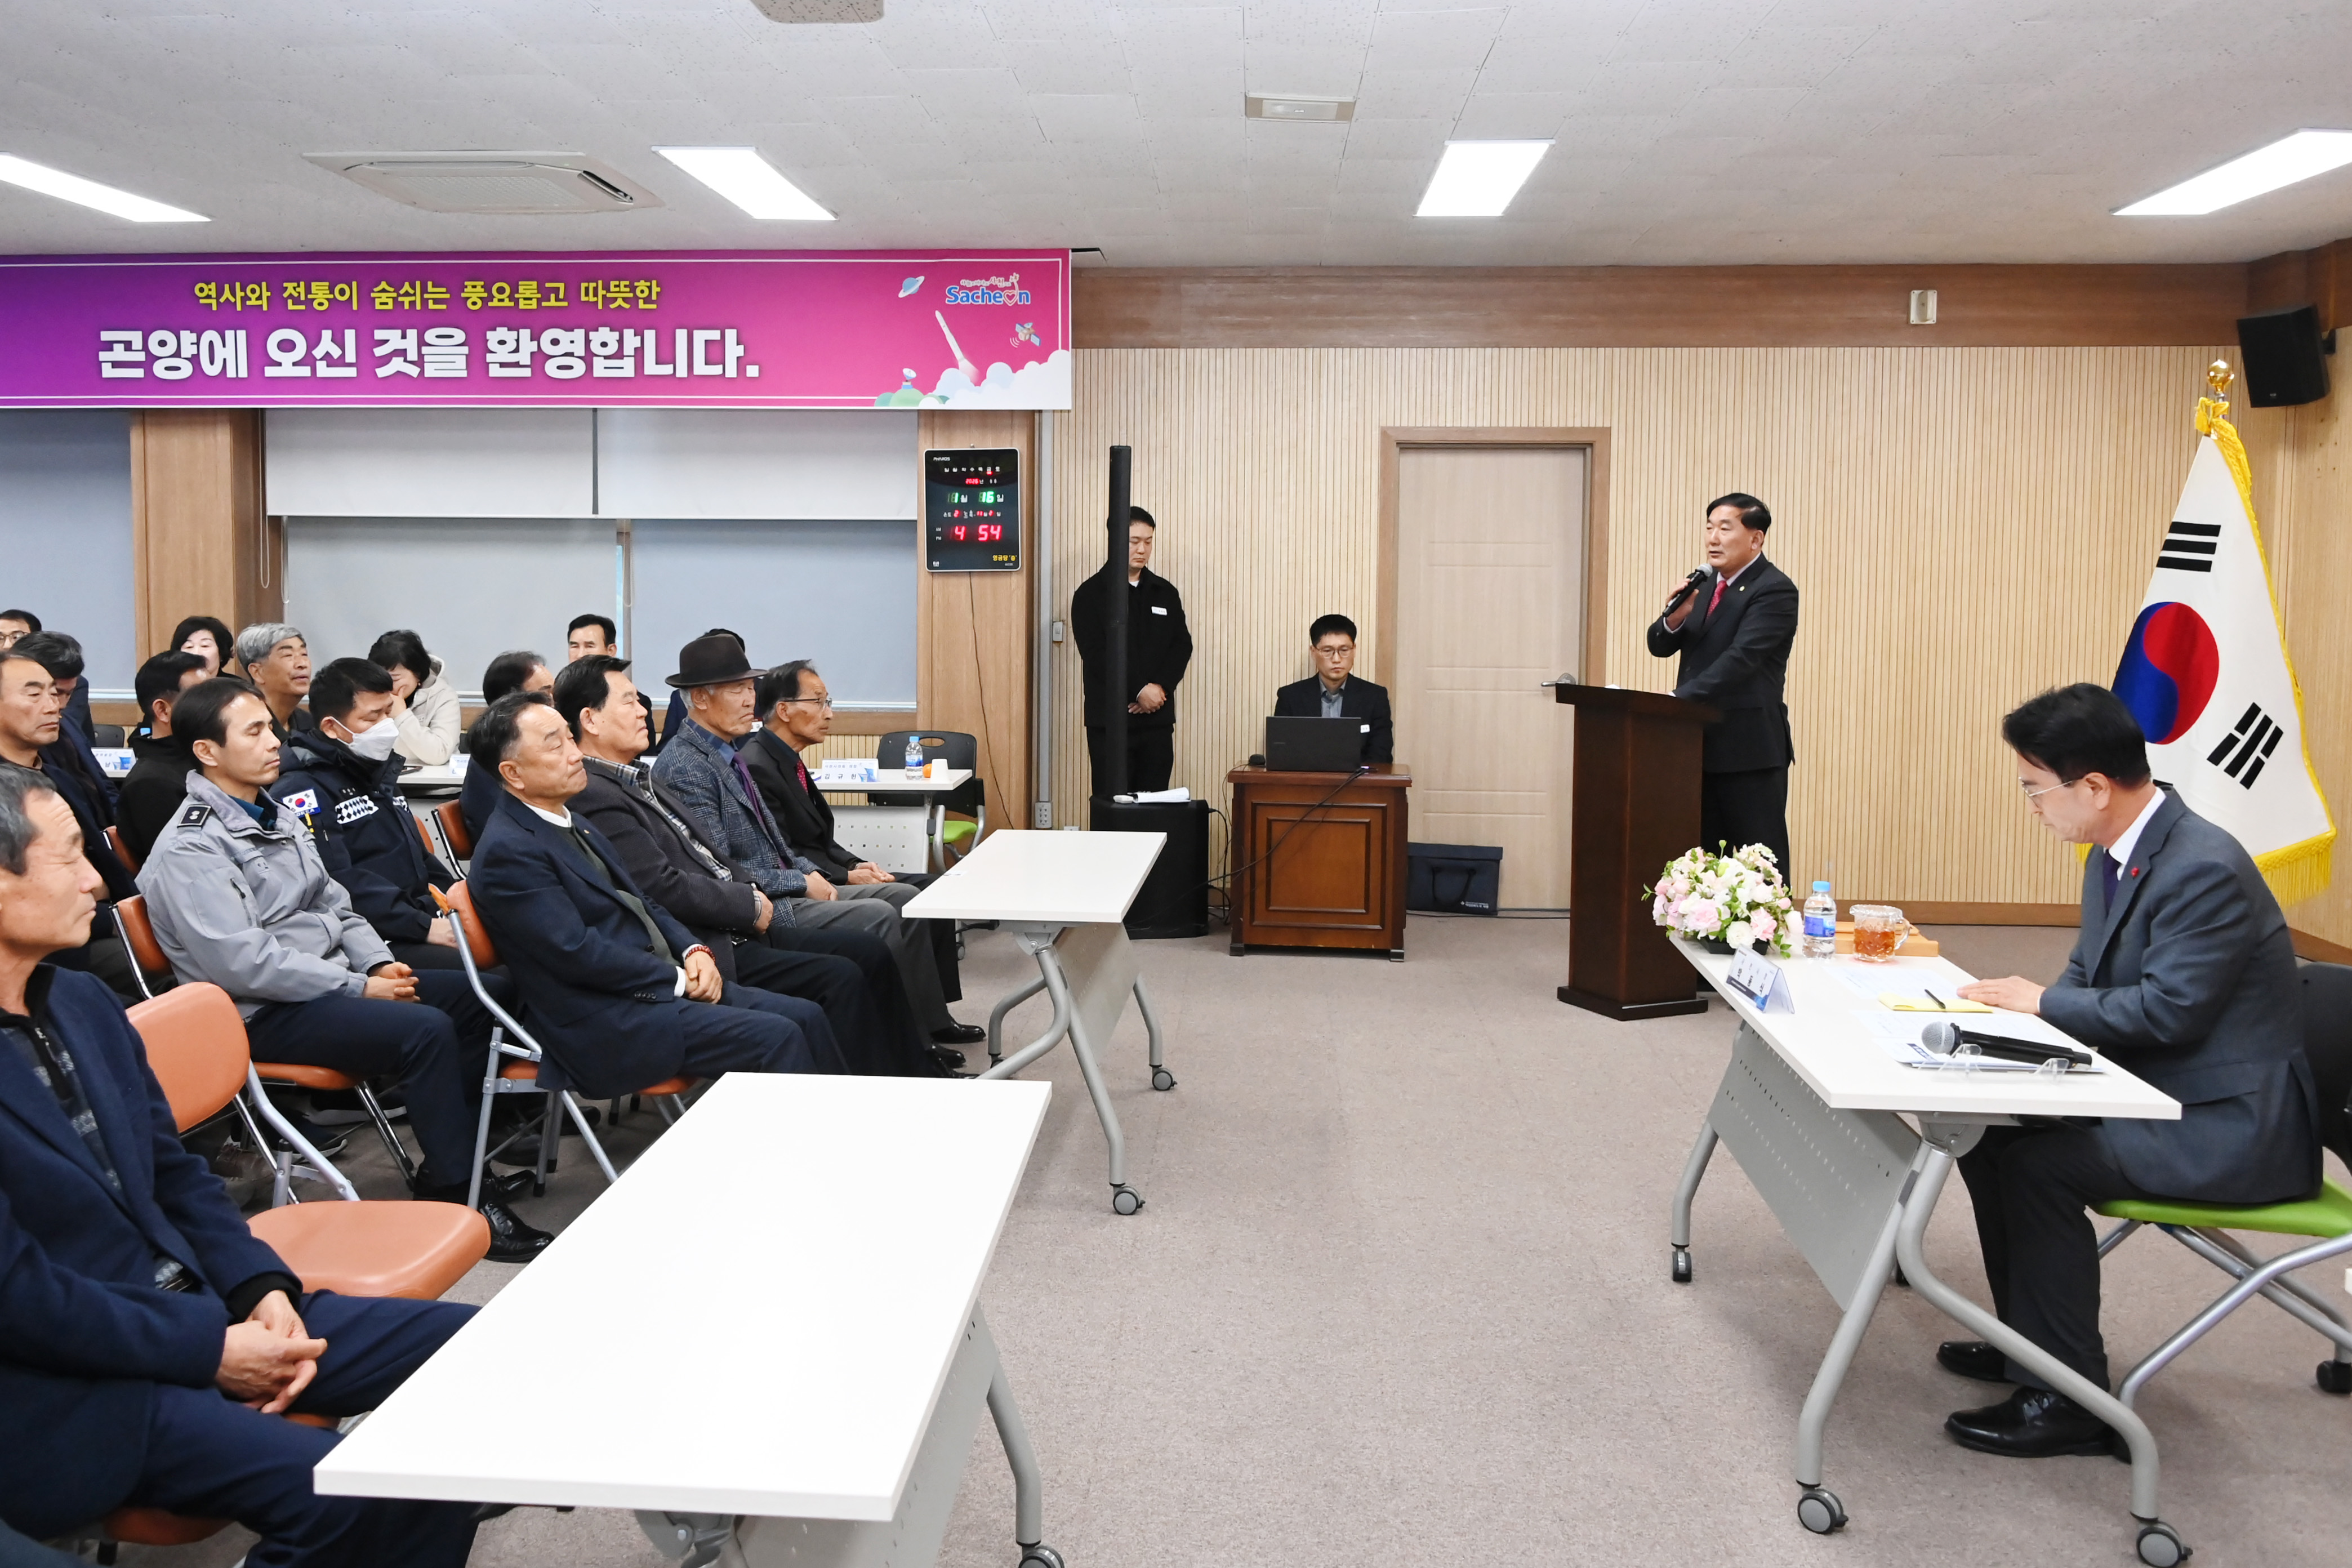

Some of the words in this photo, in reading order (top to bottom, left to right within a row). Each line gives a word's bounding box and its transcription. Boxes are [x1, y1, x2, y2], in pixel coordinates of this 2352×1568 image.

[195, 282, 271, 311] 역사와
[284, 281, 358, 311] 전통이
[372, 280, 451, 310] 숨쉬는
[462, 281, 568, 310] 풍요롭고
[581, 280, 661, 310] 따뜻한
[946, 286, 1031, 306] Sacheon
[99, 330, 248, 380] 곤양에
[264, 328, 357, 377] 오신
[373, 327, 469, 378] 것을
[486, 327, 759, 379] 환영합니다.
[978, 524, 1003, 541] 54
[296, 808, 315, 817] OREA
